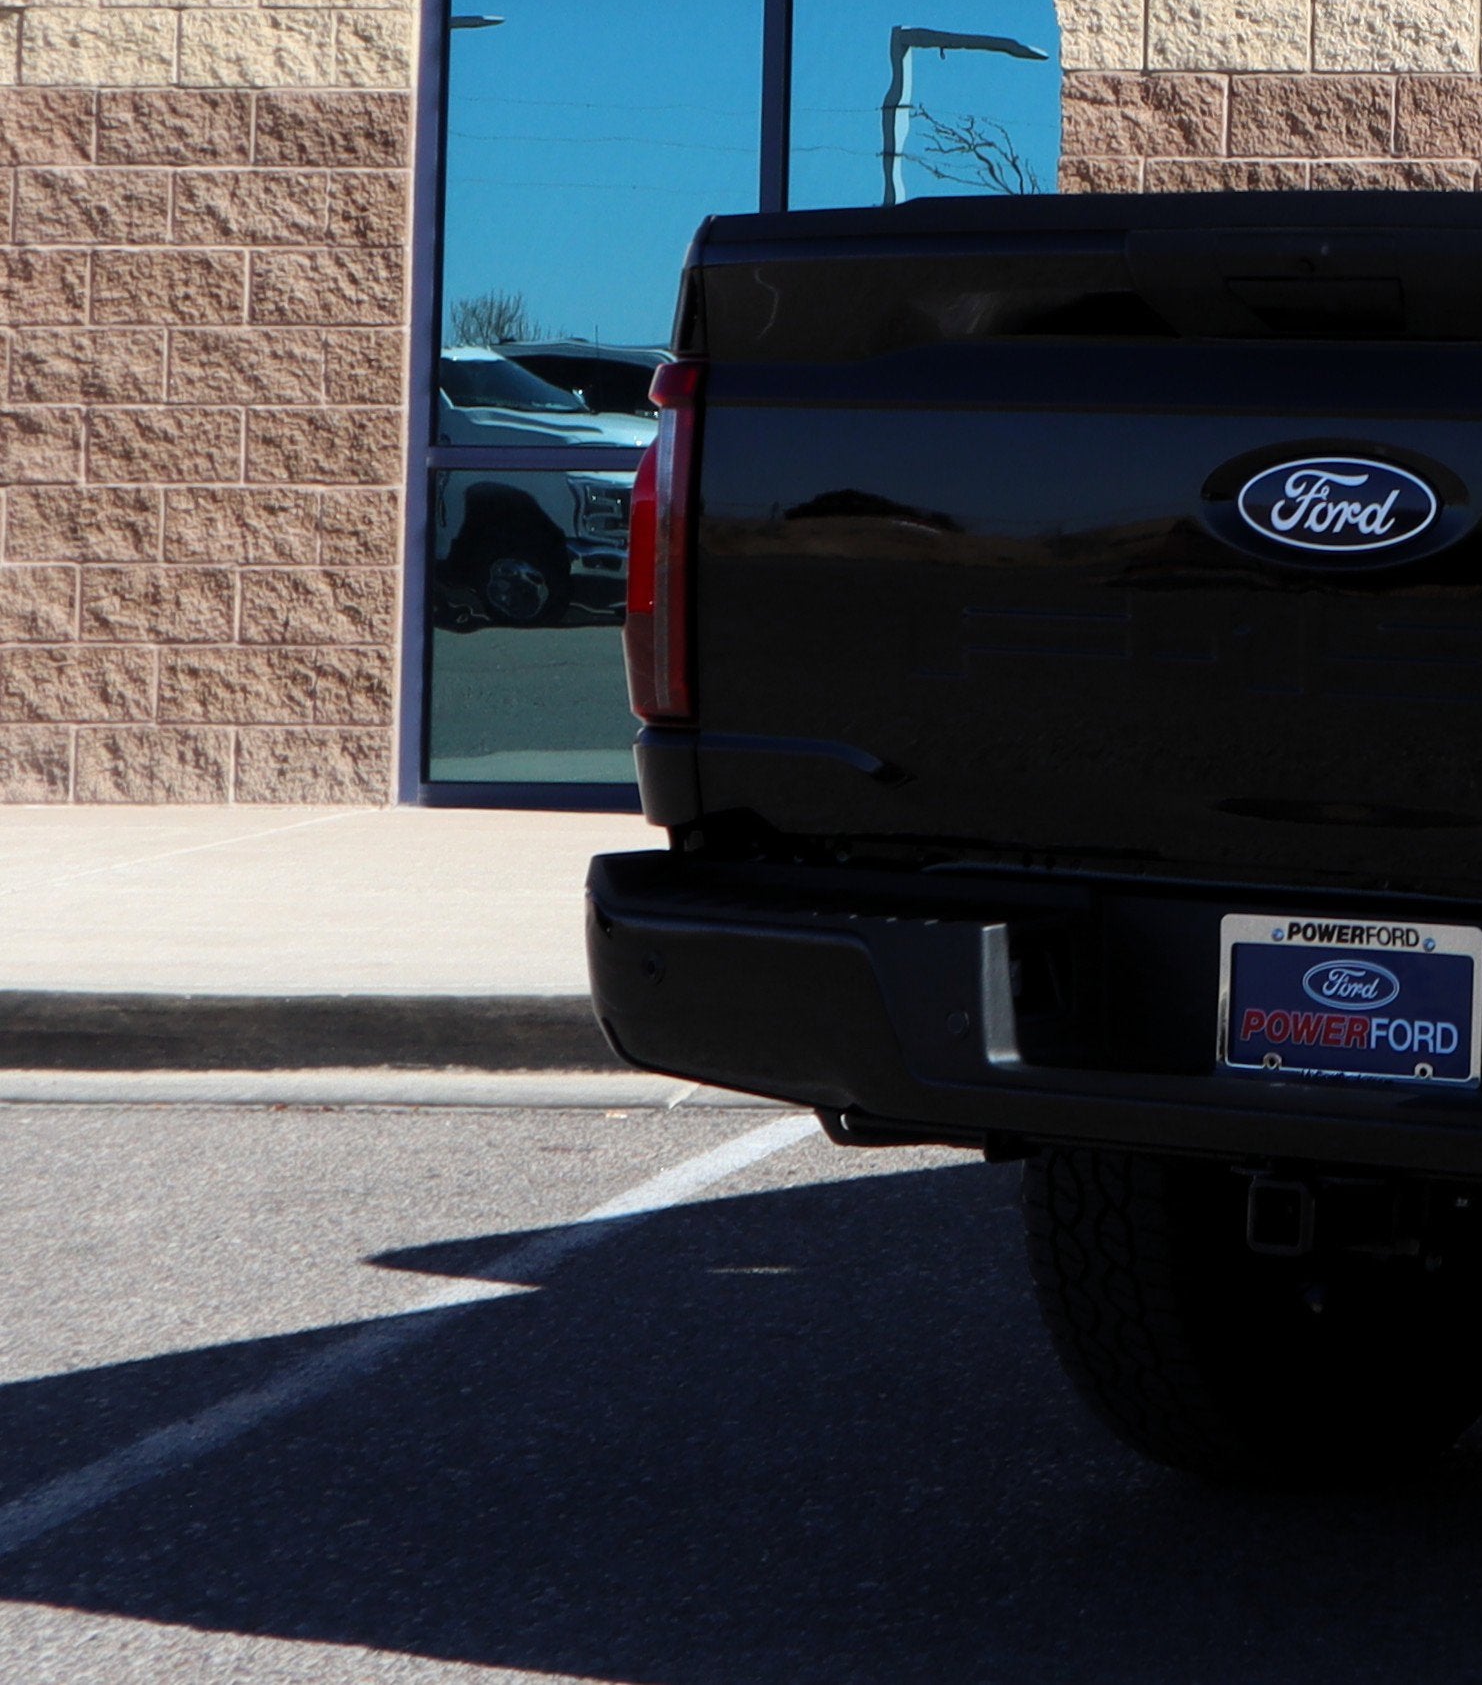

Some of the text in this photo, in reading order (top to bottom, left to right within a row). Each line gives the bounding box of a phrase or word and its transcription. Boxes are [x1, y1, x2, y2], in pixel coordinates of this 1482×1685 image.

[1271, 469, 1400, 535] Ford
[1287, 922, 1420, 947] POWERFORD
[1322, 968, 1380, 999] Ford
[1241, 1009, 1458, 1054] POWERFORD
